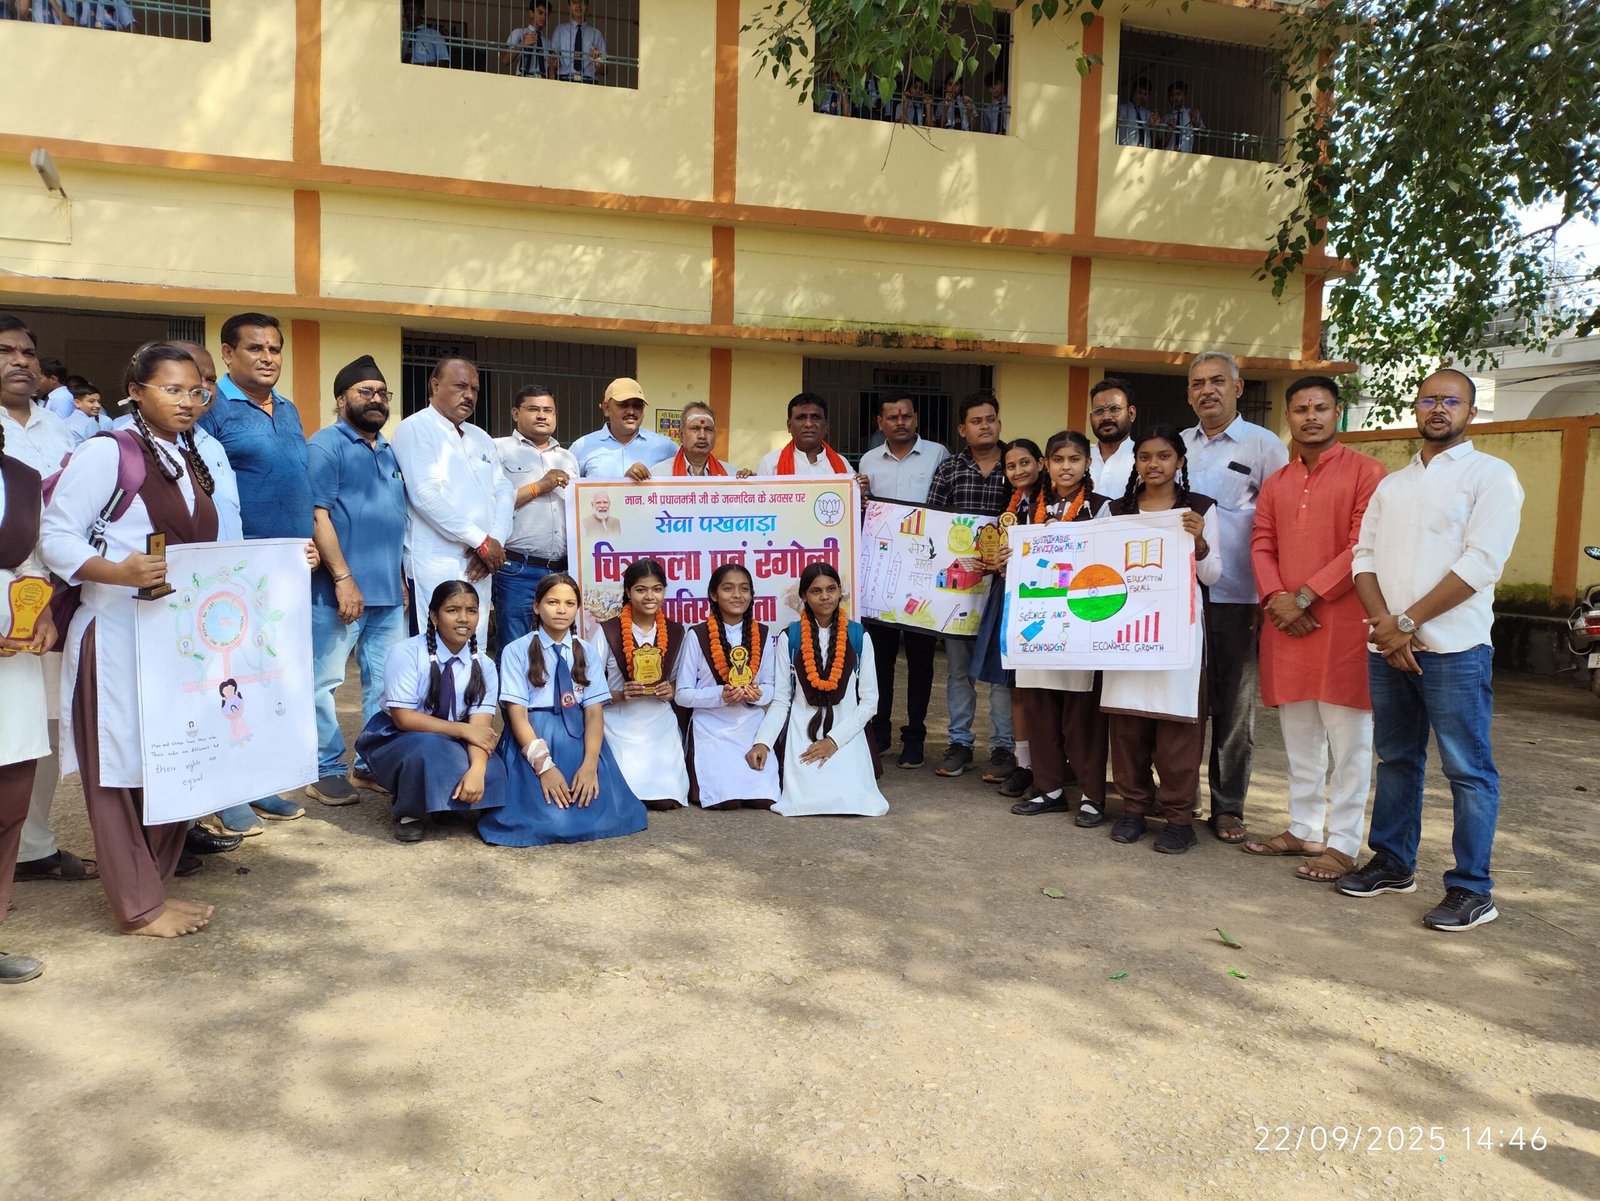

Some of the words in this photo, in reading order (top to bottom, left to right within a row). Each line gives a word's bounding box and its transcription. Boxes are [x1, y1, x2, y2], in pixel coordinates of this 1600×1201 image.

[625, 495, 645, 505] मान.
[648, 492, 658, 505] श्री
[699, 492, 709, 504] जी
[710, 492, 719, 504] के
[722, 491, 755, 504] जन्मदिन
[757, 491, 766, 503] के
[769, 493, 793, 504] अवसर
[795, 493, 806, 503] पर
[655, 510, 694, 534] सेवा
[699, 514, 777, 537] पखवाड़ा
[1051, 611, 1067, 620] AND
[1134, 643, 1164, 652] GROWTH
[182, 773, 203, 792] equal
